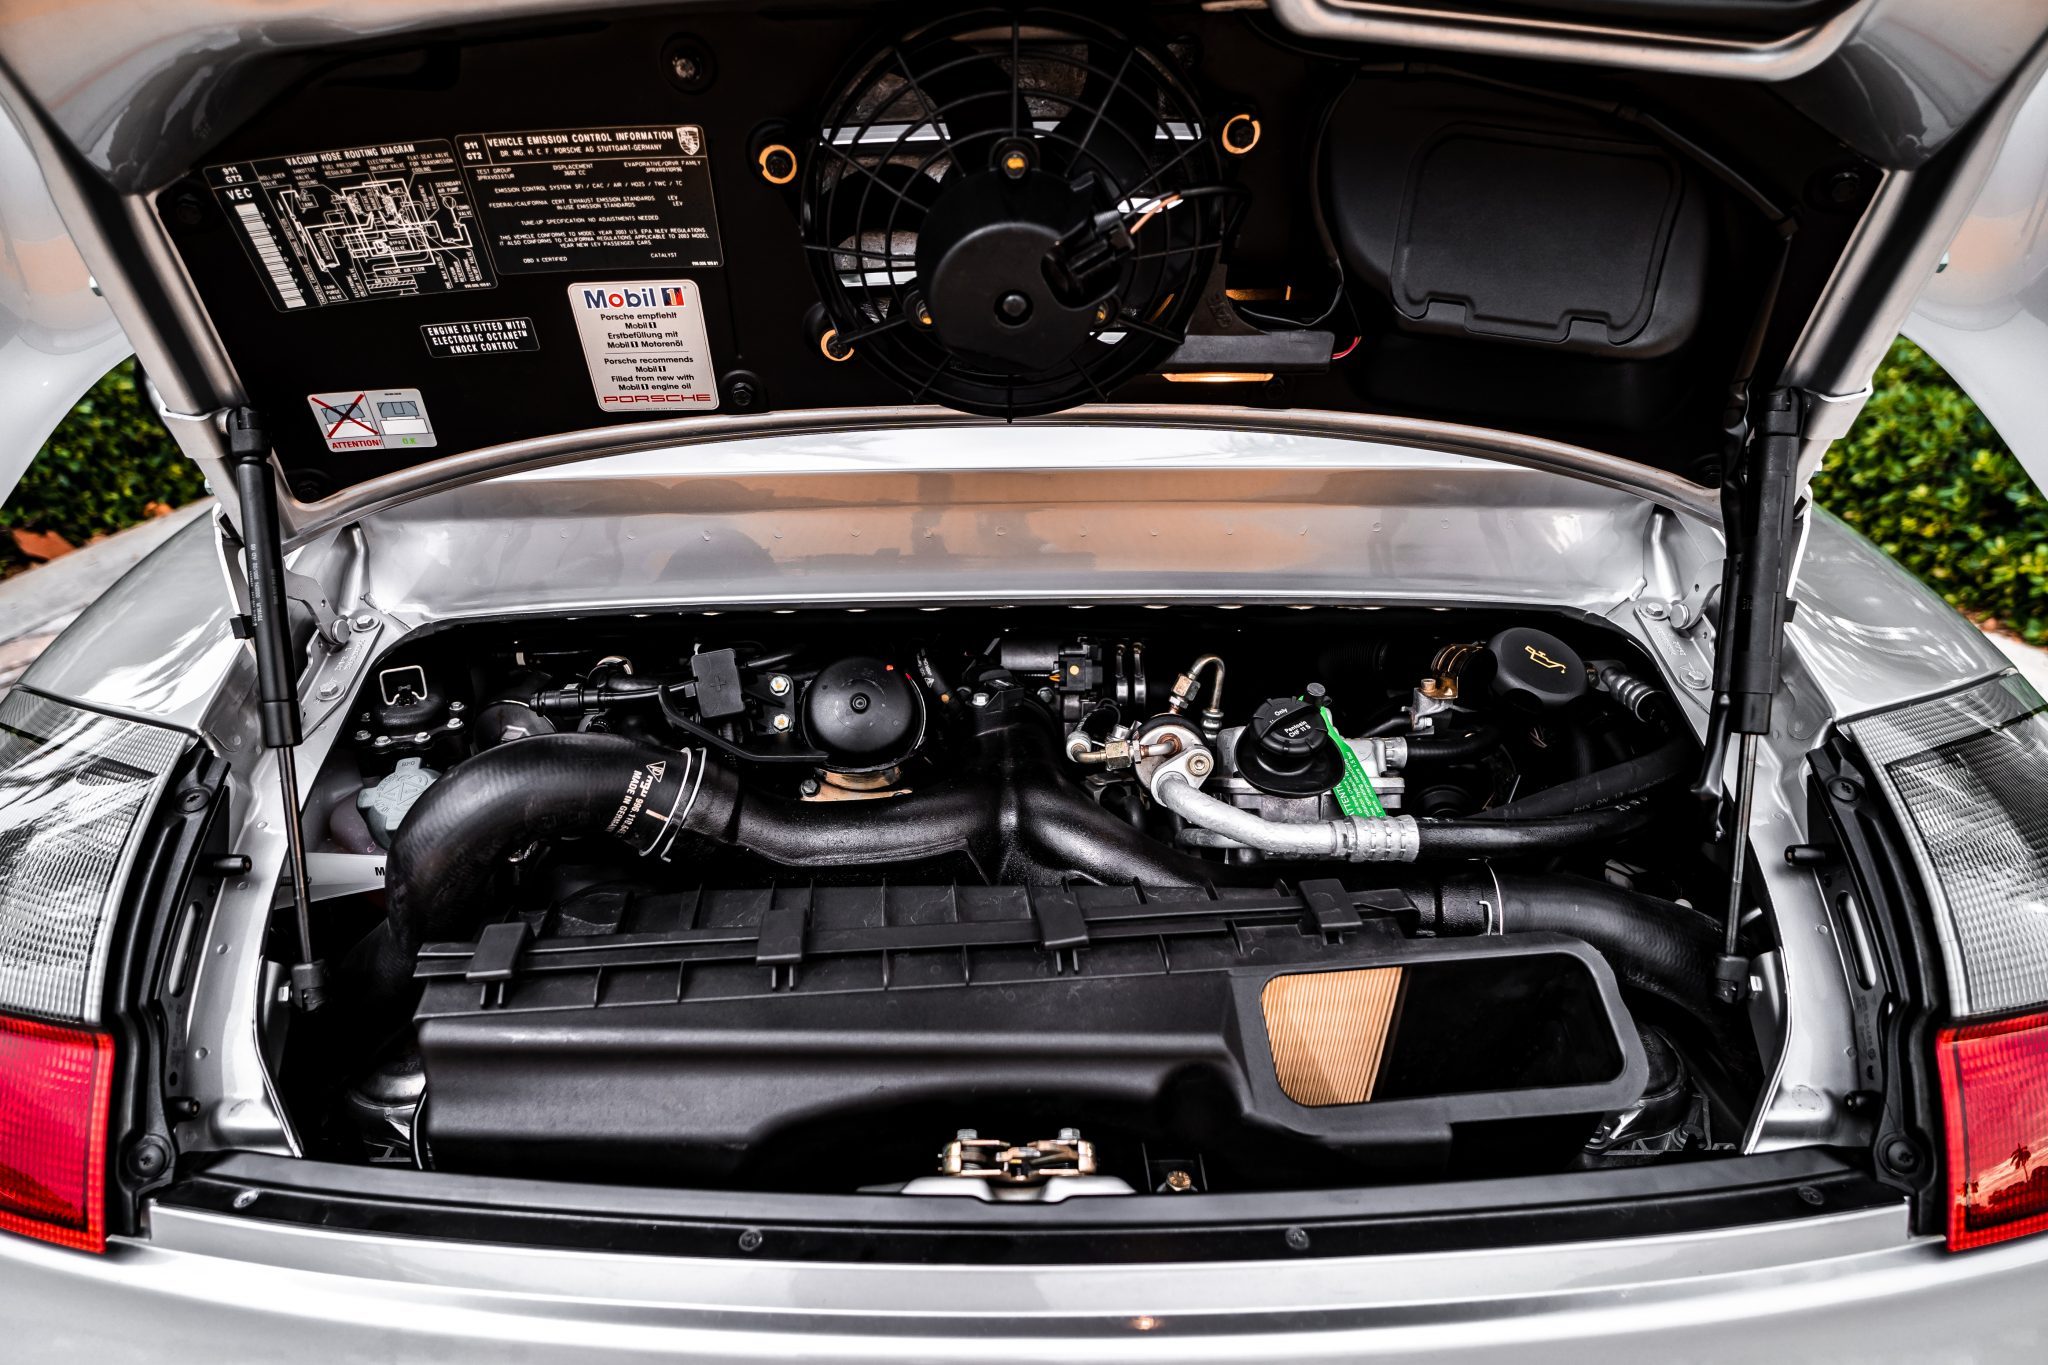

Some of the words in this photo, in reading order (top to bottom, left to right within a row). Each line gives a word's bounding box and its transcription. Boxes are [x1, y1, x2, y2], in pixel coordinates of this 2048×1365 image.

[487, 137, 524, 147] VEHICLE
[527, 135, 568, 145] EMISSION
[572, 133, 612, 143] CONTROL
[616, 131, 674, 140] INFORMATION
[464, 142, 479, 150] 911
[597, 144, 662, 152] STUTTGART-GERMANY
[285, 155, 319, 166] VACUUM
[320, 152, 342, 161] HOSE
[344, 148, 379, 159] ROUTING
[380, 144, 415, 155] DIAGRAM
[222, 166, 238, 175] 911
[225, 175, 243, 183] GT2
[226, 188, 252, 200] VEC
[584, 288, 656, 309] Mobil
[637, 312, 677, 320] empfiehlt
[427, 325, 459, 336] ENGINE
[461, 324, 471, 333] IS
[473, 322, 503, 332] FITTED
[505, 320, 526, 330] WITH
[432, 334, 484, 345] ELECTRONIC
[641, 340, 683, 348] Motorenöl
[450, 344, 478, 353] KNOCK
[481, 341, 518, 351] CONTROL
[604, 394, 711, 403] PORSCHE
[332, 440, 383, 449] ATTENTION!
[1274, 708, 1288, 716] Only
[1284, 721, 1307, 733] Pentosin
[627, 770, 642, 795] MADE
[623, 795, 632, 805] IN
